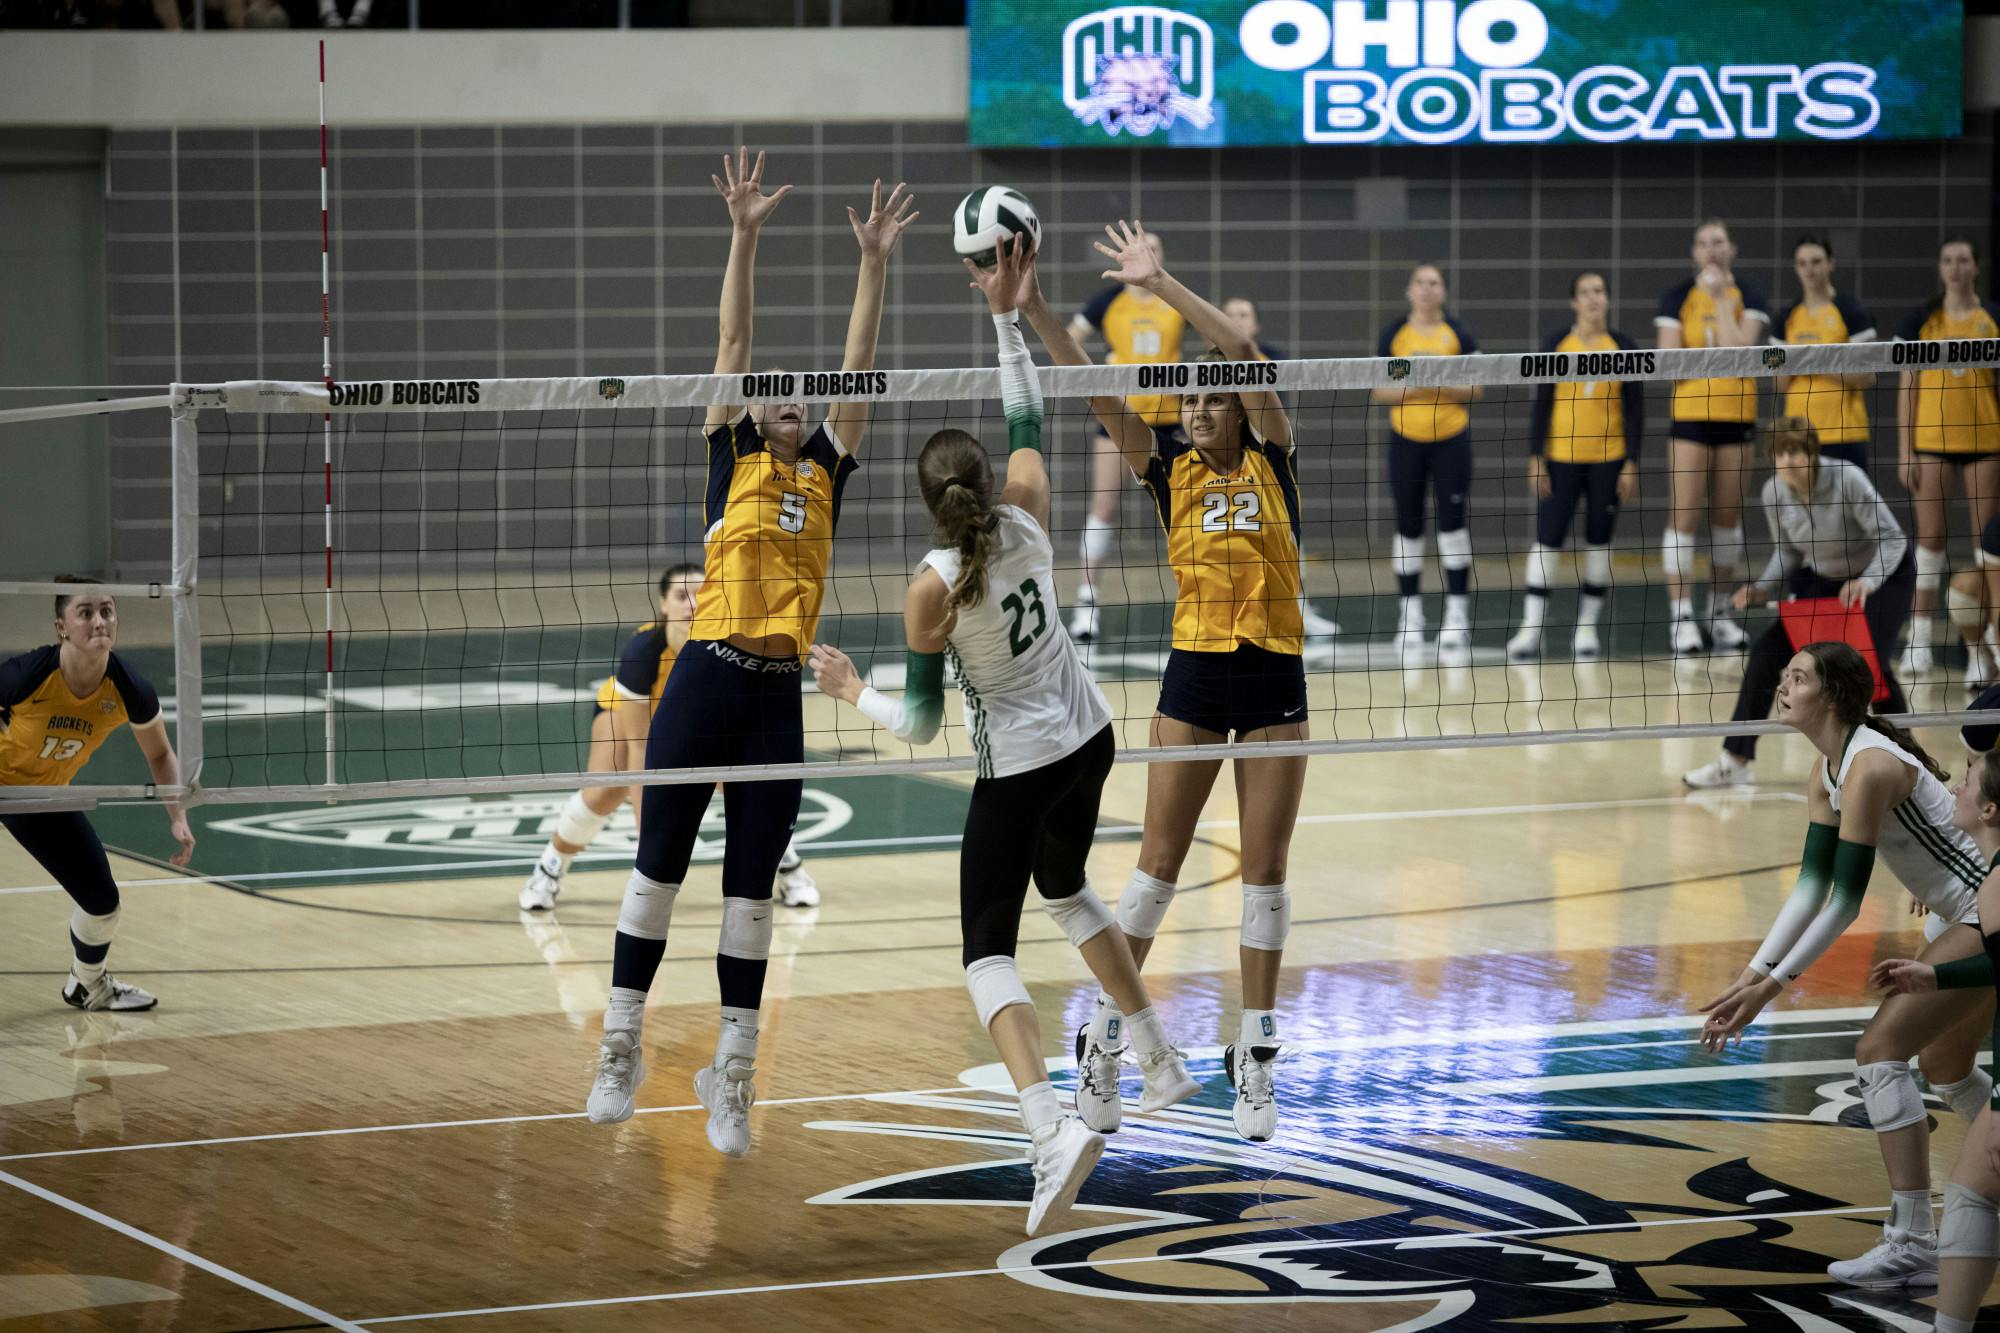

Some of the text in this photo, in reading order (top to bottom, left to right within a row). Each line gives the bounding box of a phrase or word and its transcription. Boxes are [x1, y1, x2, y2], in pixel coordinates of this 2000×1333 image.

[1240, 0, 1548, 70] OHIO
[1303, 62, 1881, 143] BOBCATS
[1520, 352, 1655, 377] OHIO BOBCATS
[1892, 341, 1940, 364] OHIO
[743, 372, 887, 397] OHIO BOBCATS
[1138, 363, 1277, 388] OHIO BOBCATS
[329, 381, 480, 406] OHIO BOBCATS
[778, 491, 807, 534] 5
[1202, 490, 1260, 533] 22
[1000, 577, 1047, 658] 23
[706, 641, 762, 671] NIKE
[47, 715, 94, 737] ROCKETS
[37, 735, 85, 761] 13
